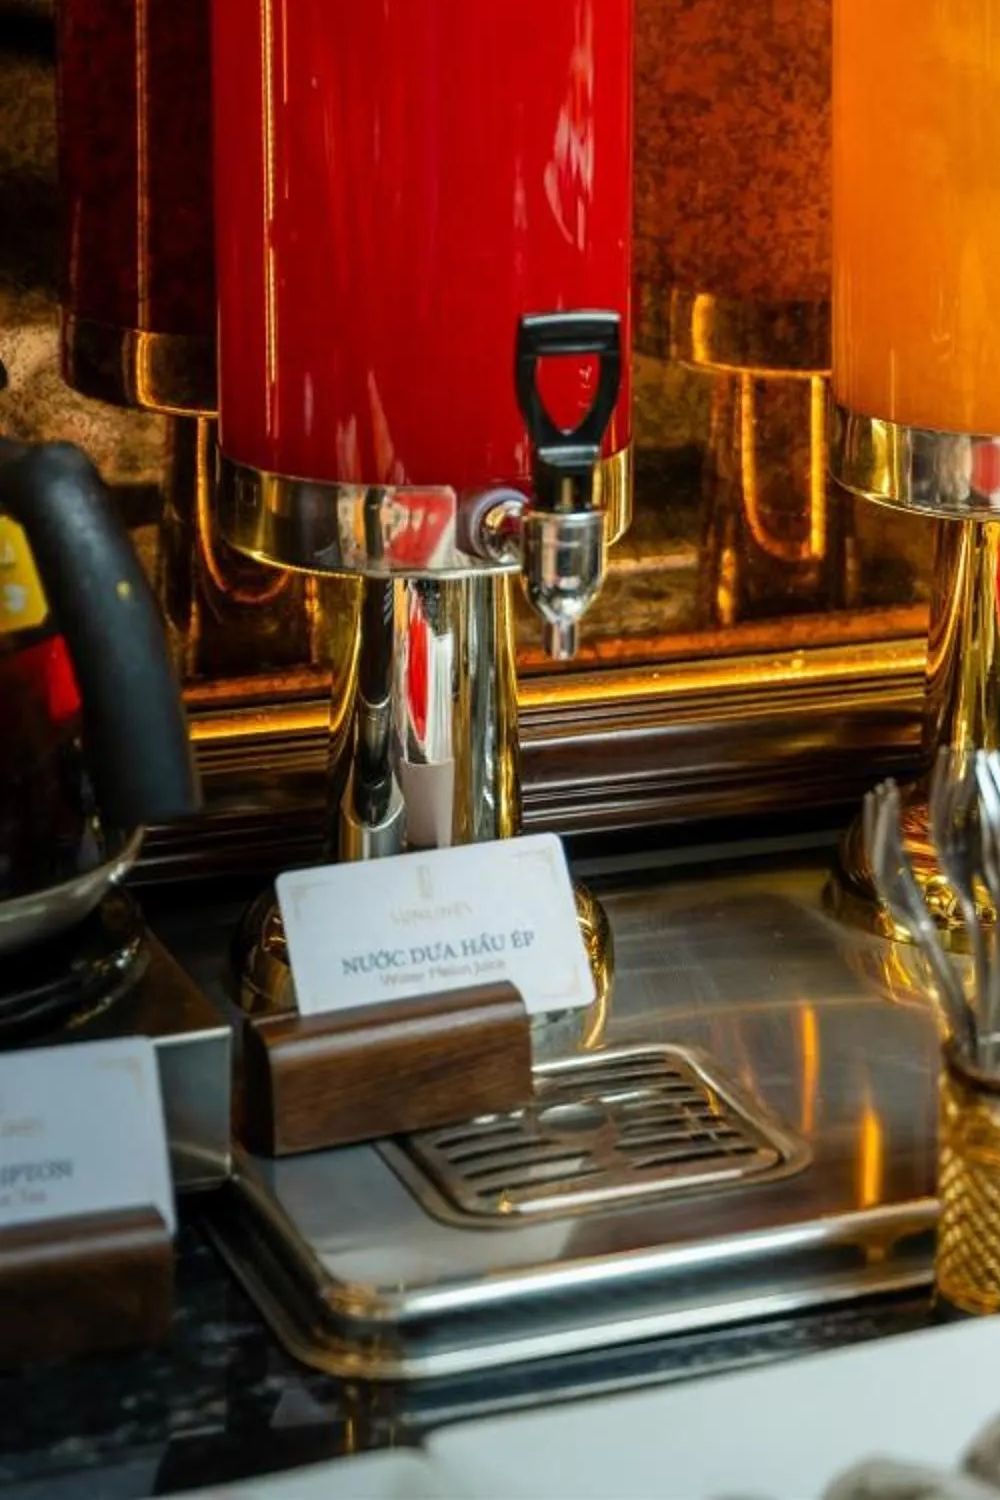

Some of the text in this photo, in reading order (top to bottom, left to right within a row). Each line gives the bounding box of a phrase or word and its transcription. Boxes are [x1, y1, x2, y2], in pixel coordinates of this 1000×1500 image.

[341, 948, 404, 977] NƯỚC
[410, 940, 459, 965] DƯA
[460, 931, 506, 957] HẤU
